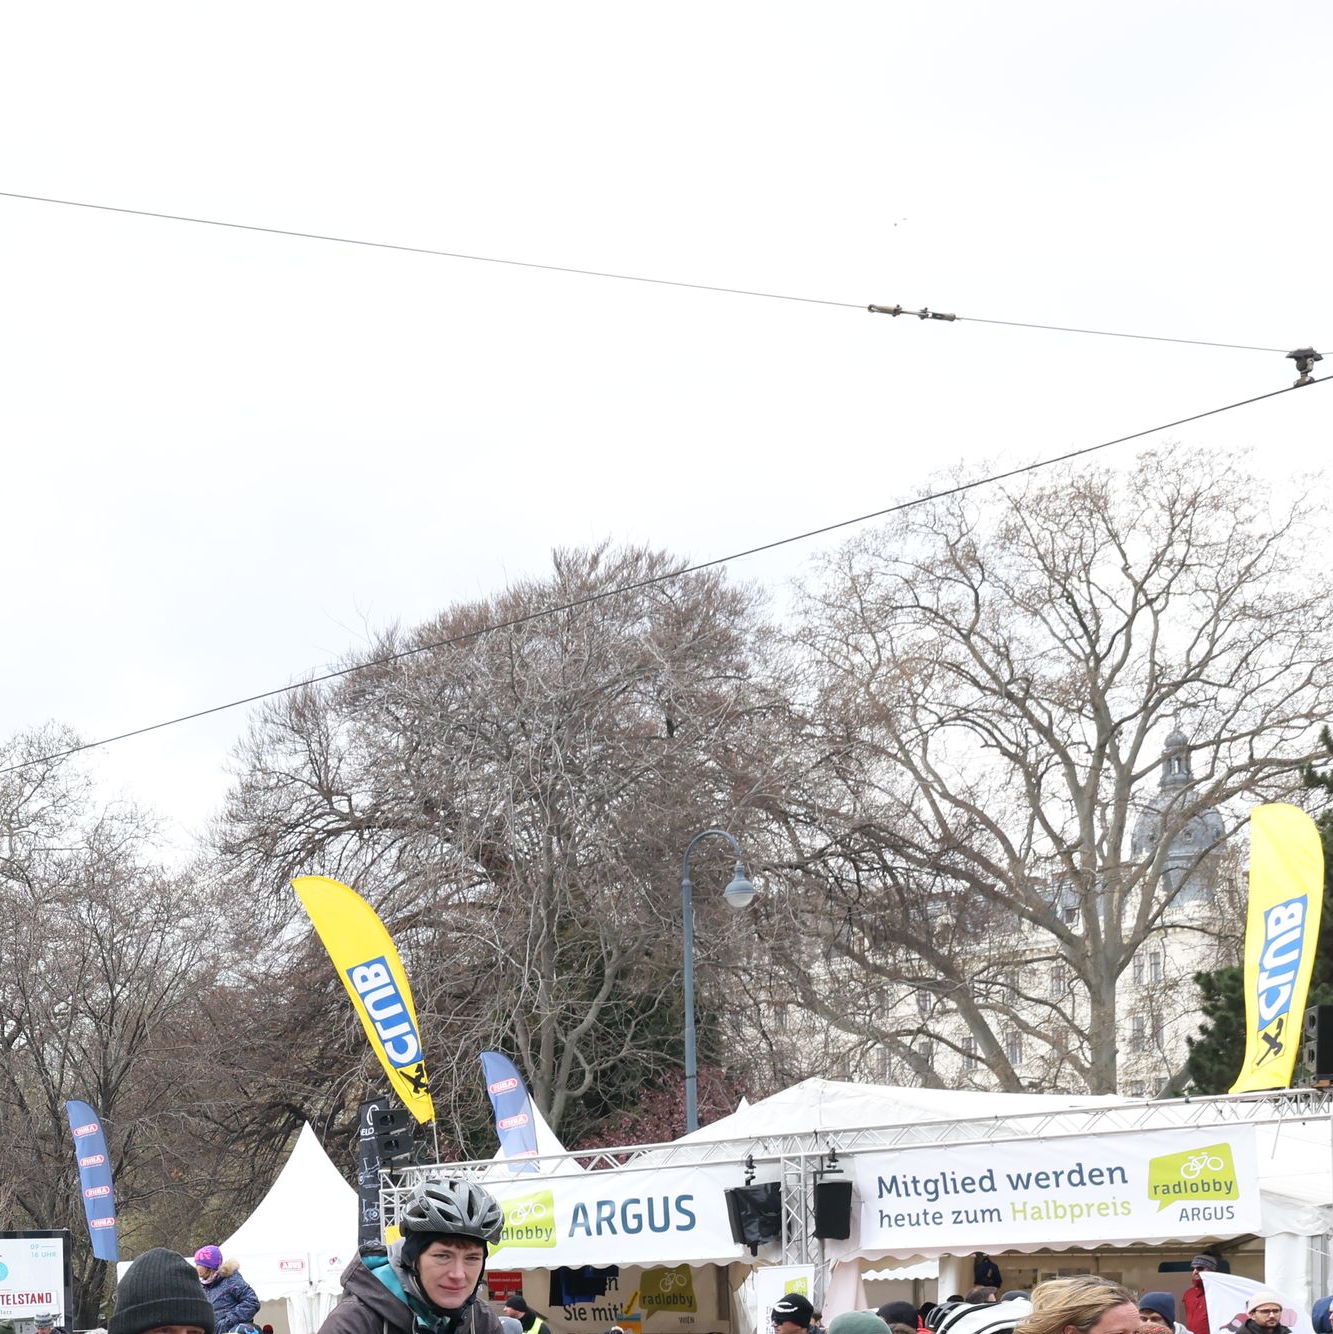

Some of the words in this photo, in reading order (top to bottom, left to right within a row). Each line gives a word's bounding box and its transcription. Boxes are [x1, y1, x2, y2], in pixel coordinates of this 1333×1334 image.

[1259, 902, 1303, 1021] CLUB
[351, 962, 419, 1064] CLUB
[877, 1170, 995, 1202] Mitglied
[1006, 1163, 1128, 1190] werden
[1153, 1178, 1234, 1196] radlobby
[568, 1195, 696, 1237] ARGUS
[879, 1209, 944, 1229] heute
[952, 1205, 1002, 1225] zum
[1011, 1196, 1132, 1224] Halbpreis
[1179, 1205, 1235, 1222] ARGUS
[501, 1226, 552, 1243] dlobby
[564, 1305, 587, 1321] Sie
